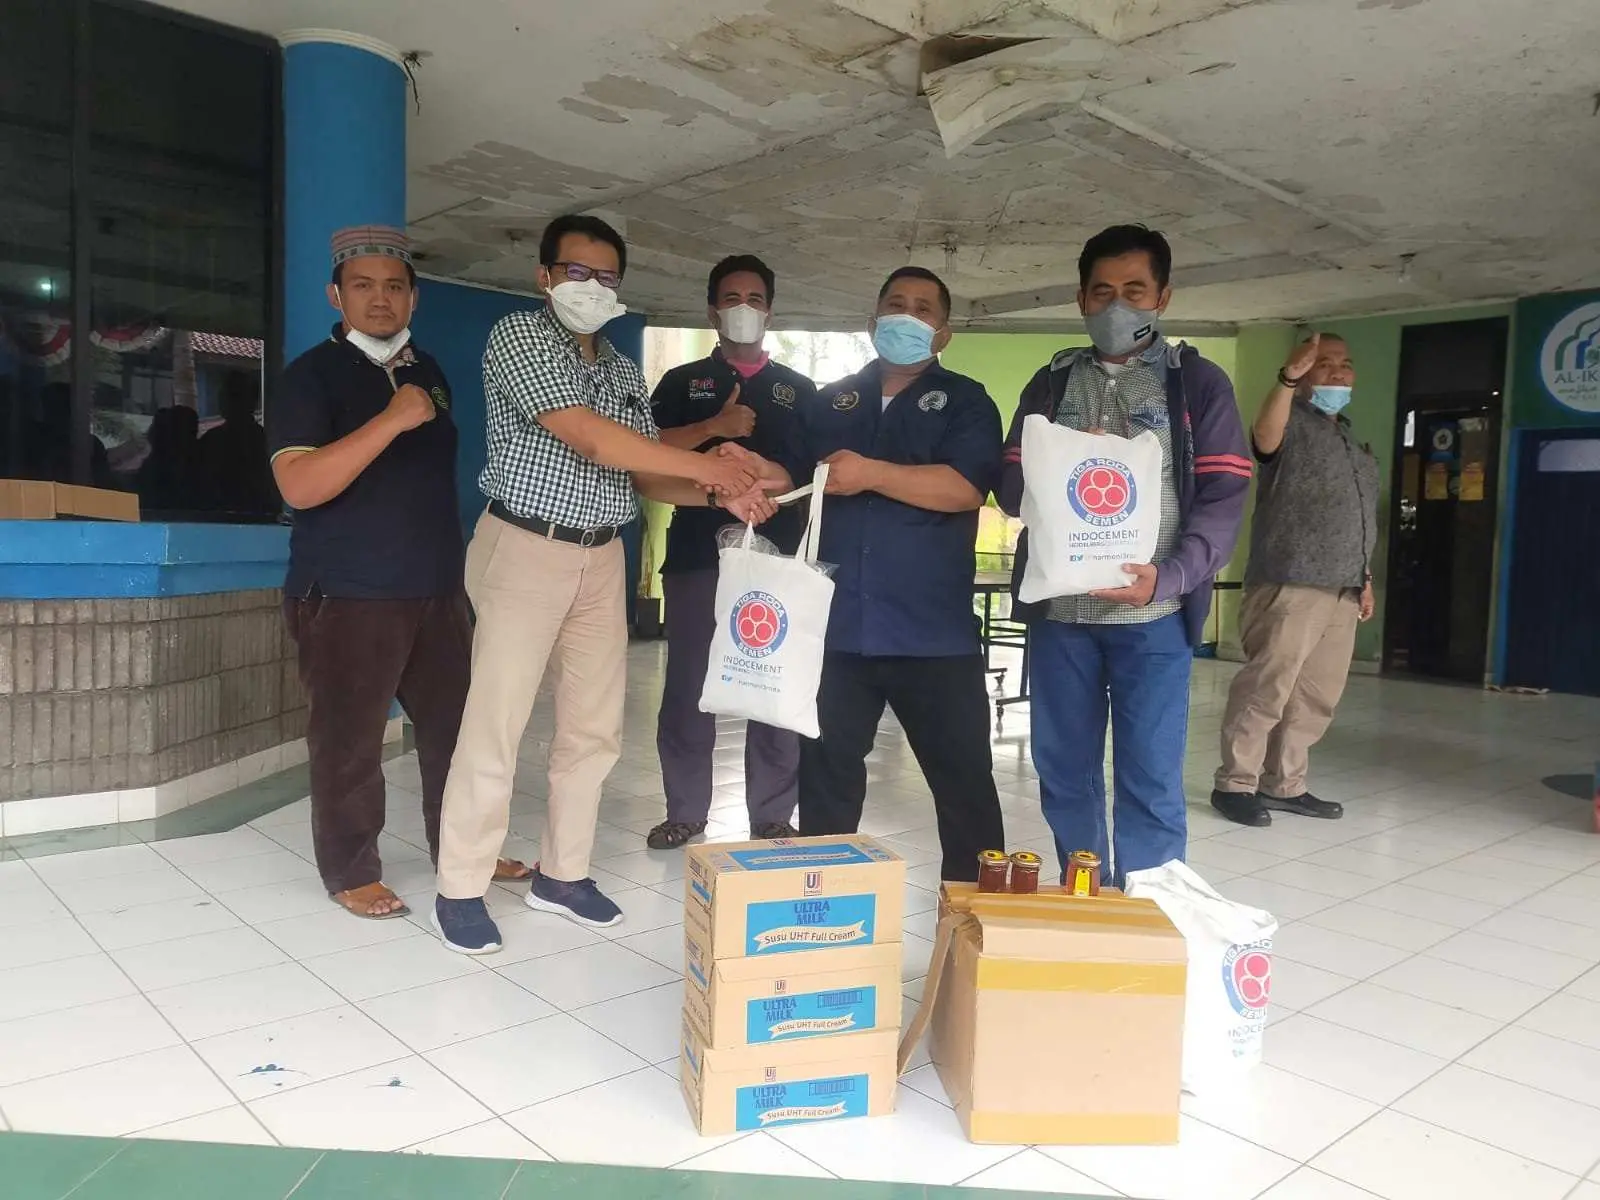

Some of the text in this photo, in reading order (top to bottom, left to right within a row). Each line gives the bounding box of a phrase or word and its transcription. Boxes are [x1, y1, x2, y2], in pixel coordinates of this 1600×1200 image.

[1554, 370, 1600, 384] AL-IK
[1070, 459, 1130, 480] TIGA RODA
[1084, 511, 1129, 526] SEMEN
[1068, 529, 1139, 541] INDOCEMENT
[736, 643, 773, 658] SEMEN
[723, 655, 784, 673] INDOCEMENT
[794, 900, 830, 914] ULTRA
[796, 912, 827, 925] MILK
[764, 930, 856, 945] Susu UHT Full Cream
[763, 998, 797, 1011] ULTRA
[766, 1009, 792, 1023] MILK
[777, 1019, 847, 1031] Susu UHT Full Cream
[753, 1084, 787, 1098] ULTRA
[767, 1111, 785, 1120] Susu
[787, 1109, 802, 1117] UHT
[818, 1107, 840, 1117] Cream
